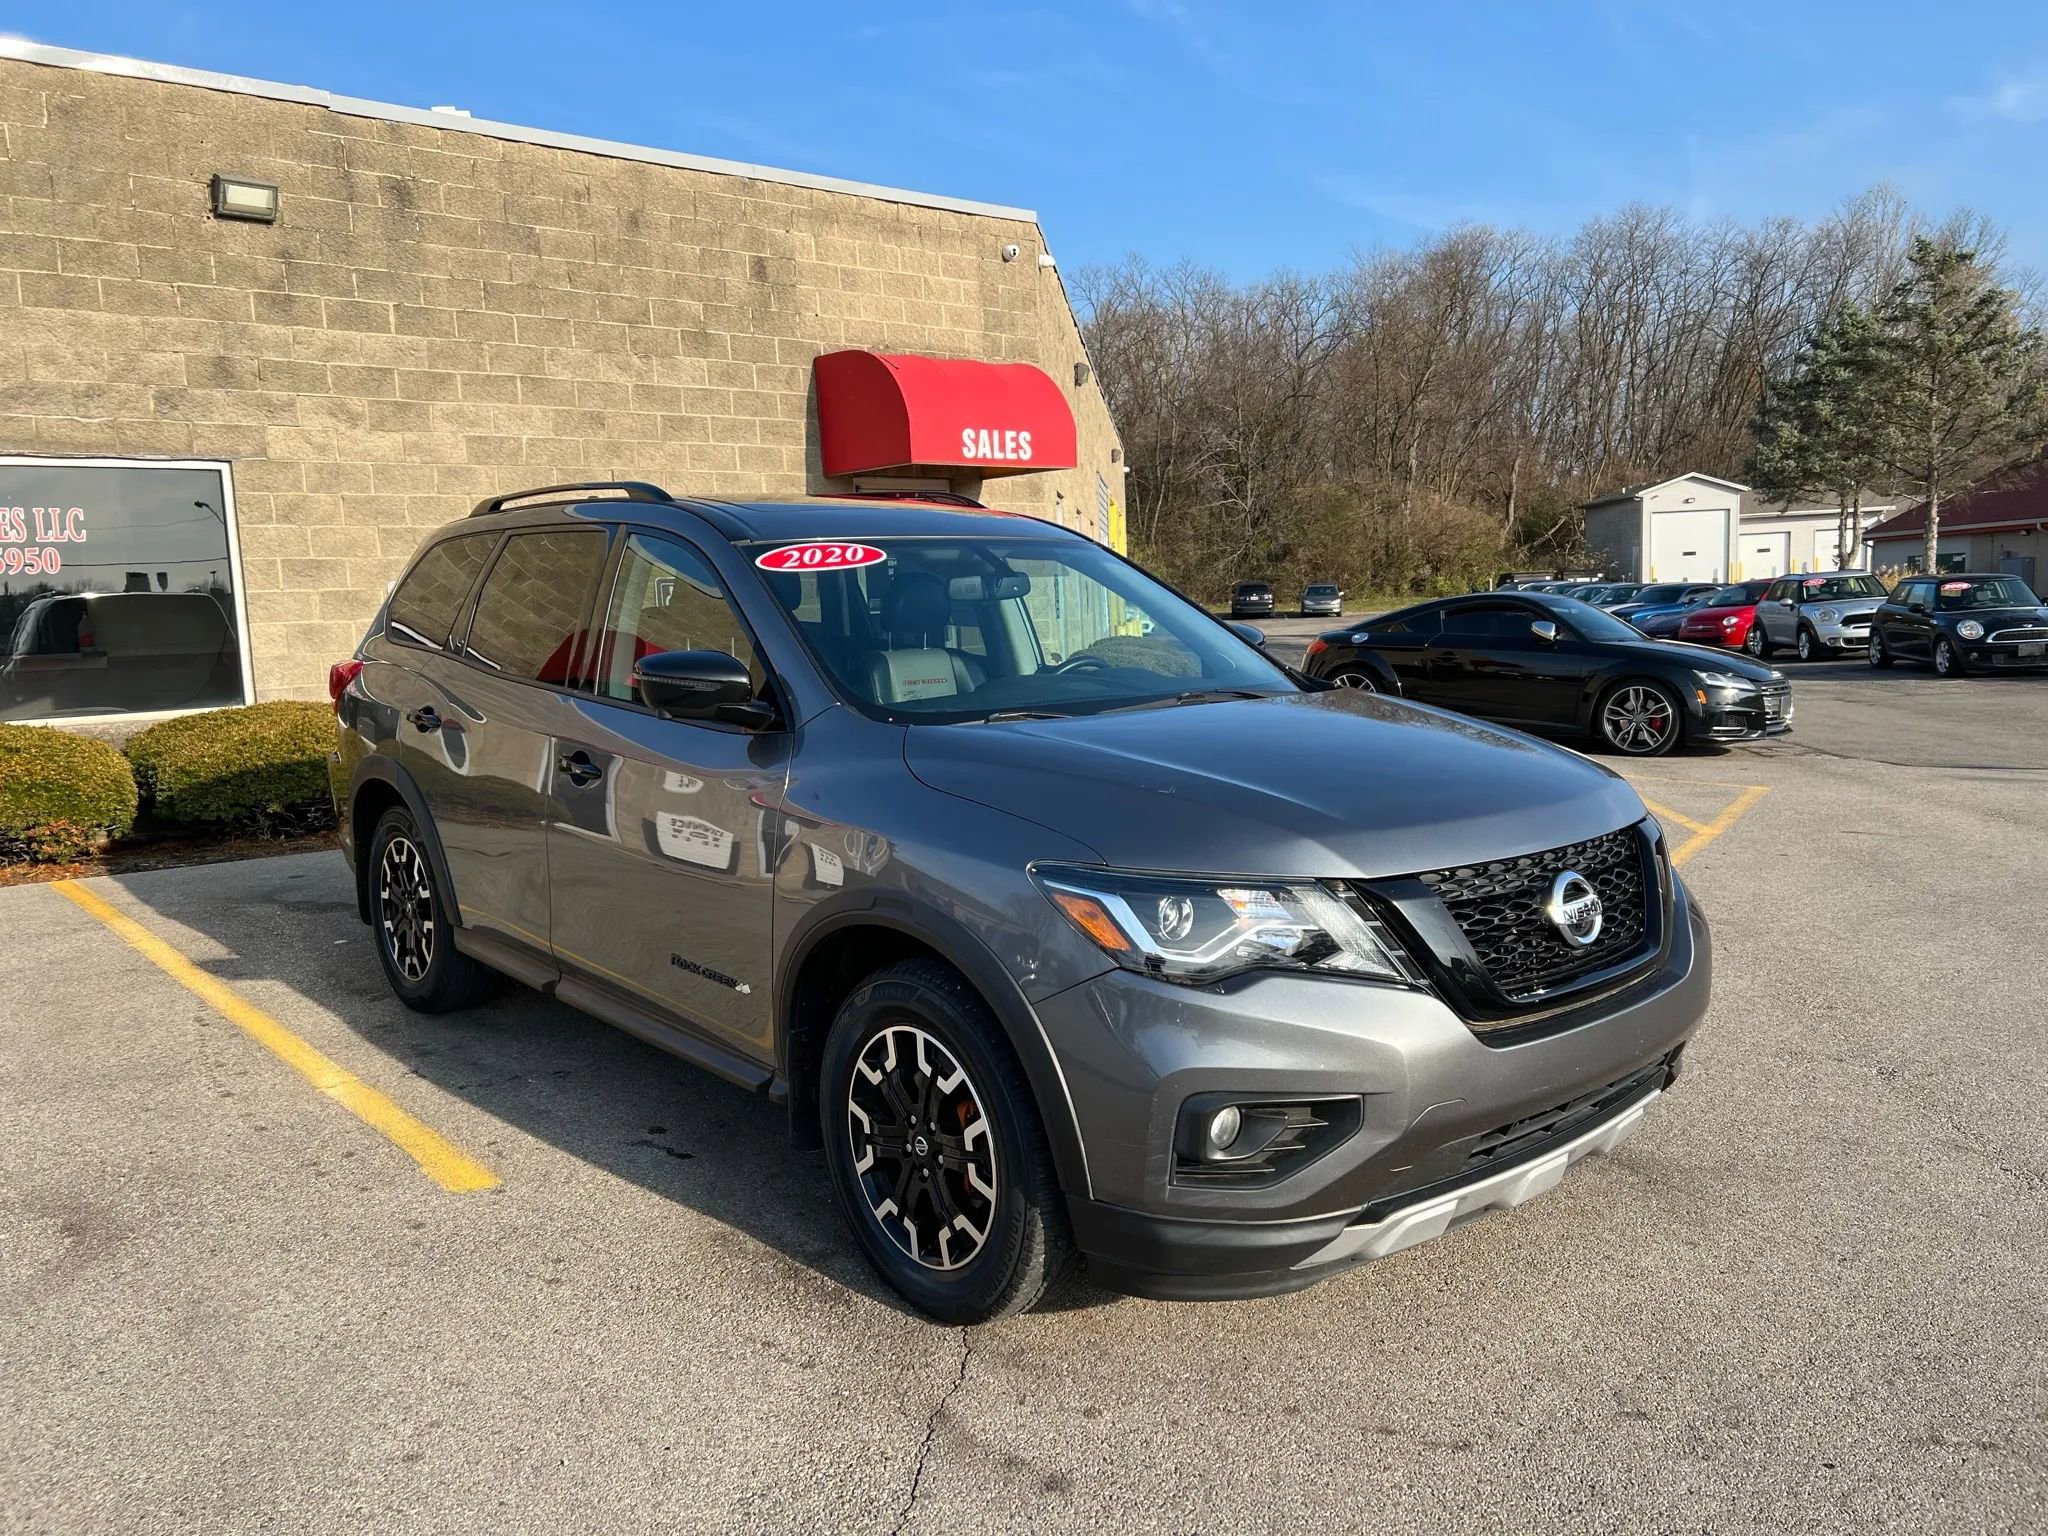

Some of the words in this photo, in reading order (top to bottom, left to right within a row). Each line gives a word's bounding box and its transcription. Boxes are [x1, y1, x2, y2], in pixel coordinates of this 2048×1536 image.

[962, 428, 1032, 460] SALES
[32, 507, 87, 542] LLC
[782, 546, 864, 568] 2020
[670, 952, 702, 975] ROCK
[701, 967, 739, 989] CREEK
